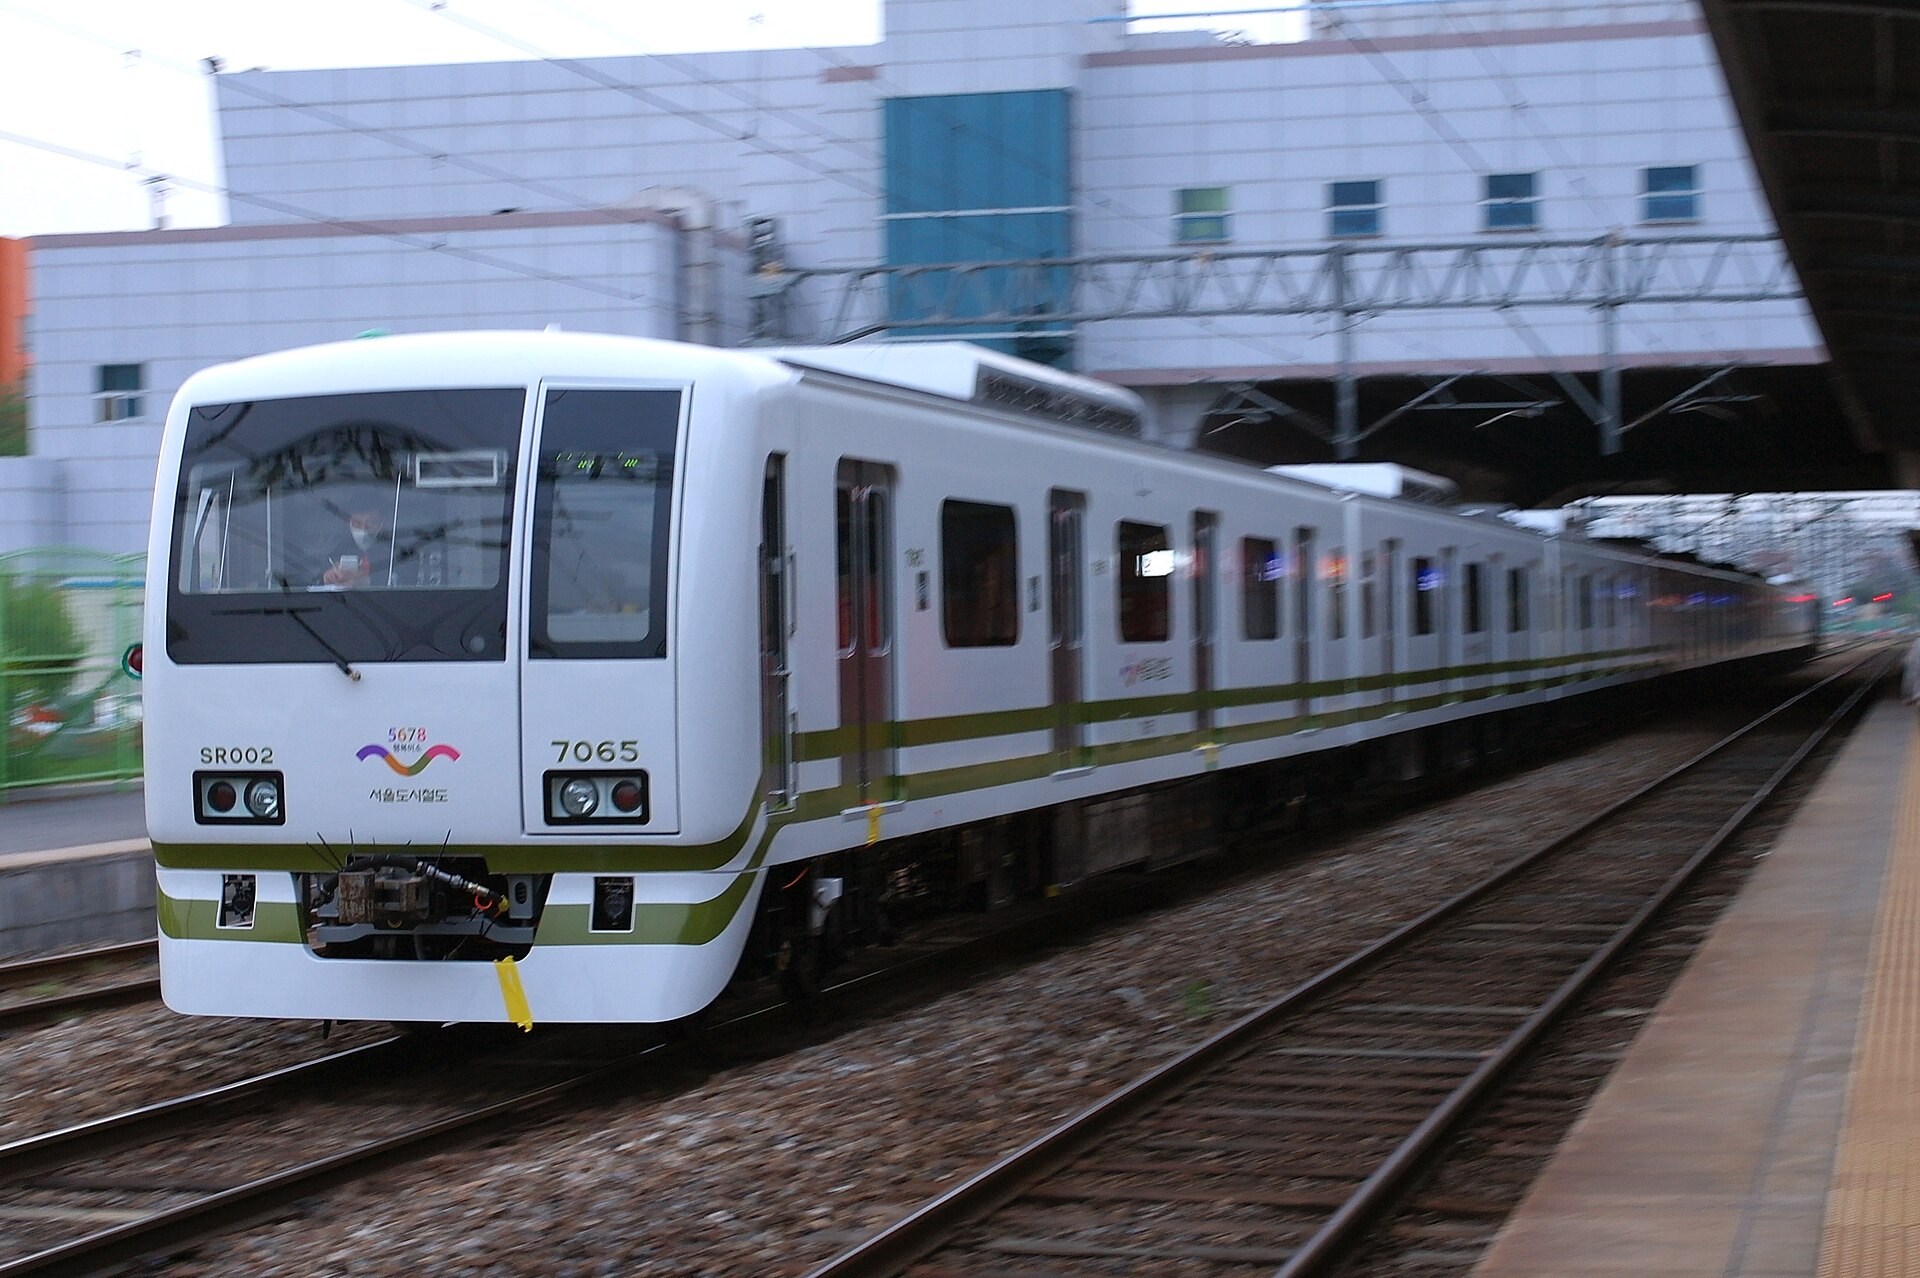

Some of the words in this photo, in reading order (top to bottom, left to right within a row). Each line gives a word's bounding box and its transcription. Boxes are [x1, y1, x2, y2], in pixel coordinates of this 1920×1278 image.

[388, 727, 426, 742] 5678
[200, 747, 273, 764] SR002
[551, 741, 638, 763] 7065
[369, 787, 448, 803] 서울도시철도
